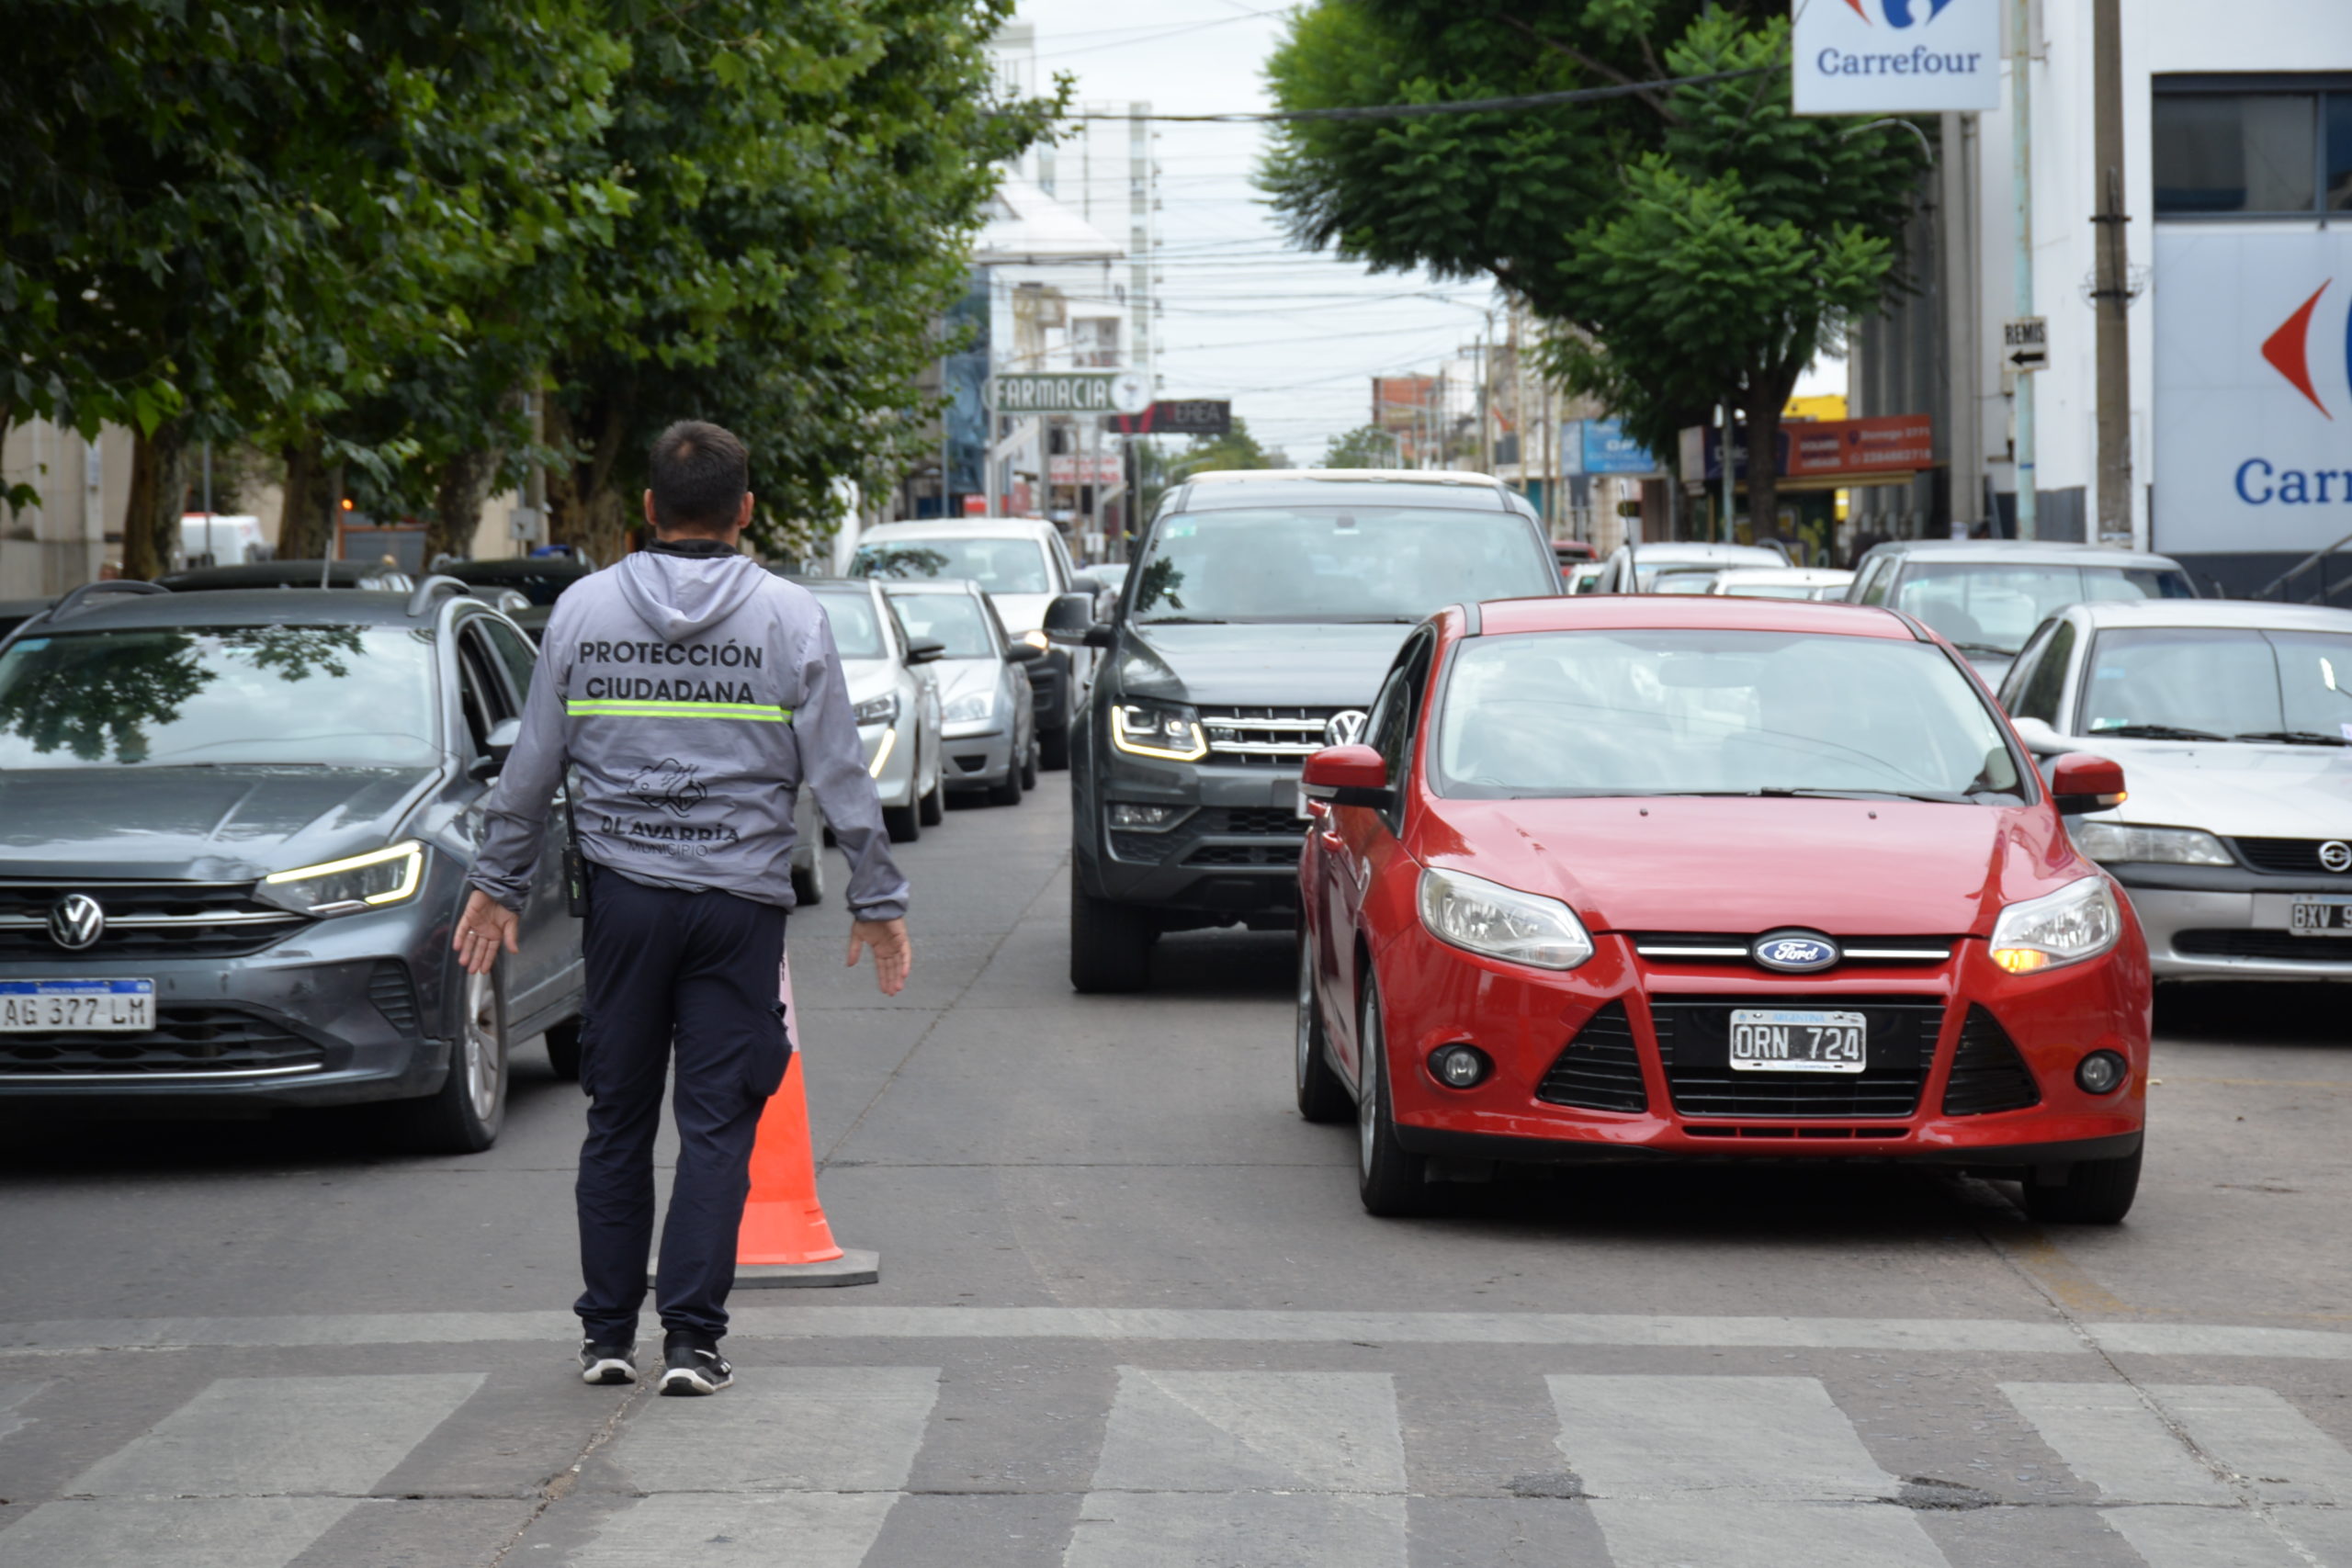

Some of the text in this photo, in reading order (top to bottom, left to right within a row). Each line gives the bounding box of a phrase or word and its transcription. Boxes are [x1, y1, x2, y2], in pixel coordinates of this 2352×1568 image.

[1816, 45, 1981, 75] Carrefour
[2005, 321, 2045, 345] REMIS
[995, 378, 1107, 409] FARMACIA
[579, 638, 763, 669] PROTECCIÓN
[585, 677, 755, 704] CIUDADANA
[627, 842, 708, 857] MUNICIPIO
[2294, 905, 2331, 928] BXV
[1774, 942, 1819, 961] Ford
[4, 998, 145, 1026] AG 377 LM
[1736, 1025, 1860, 1060] ORN 724
